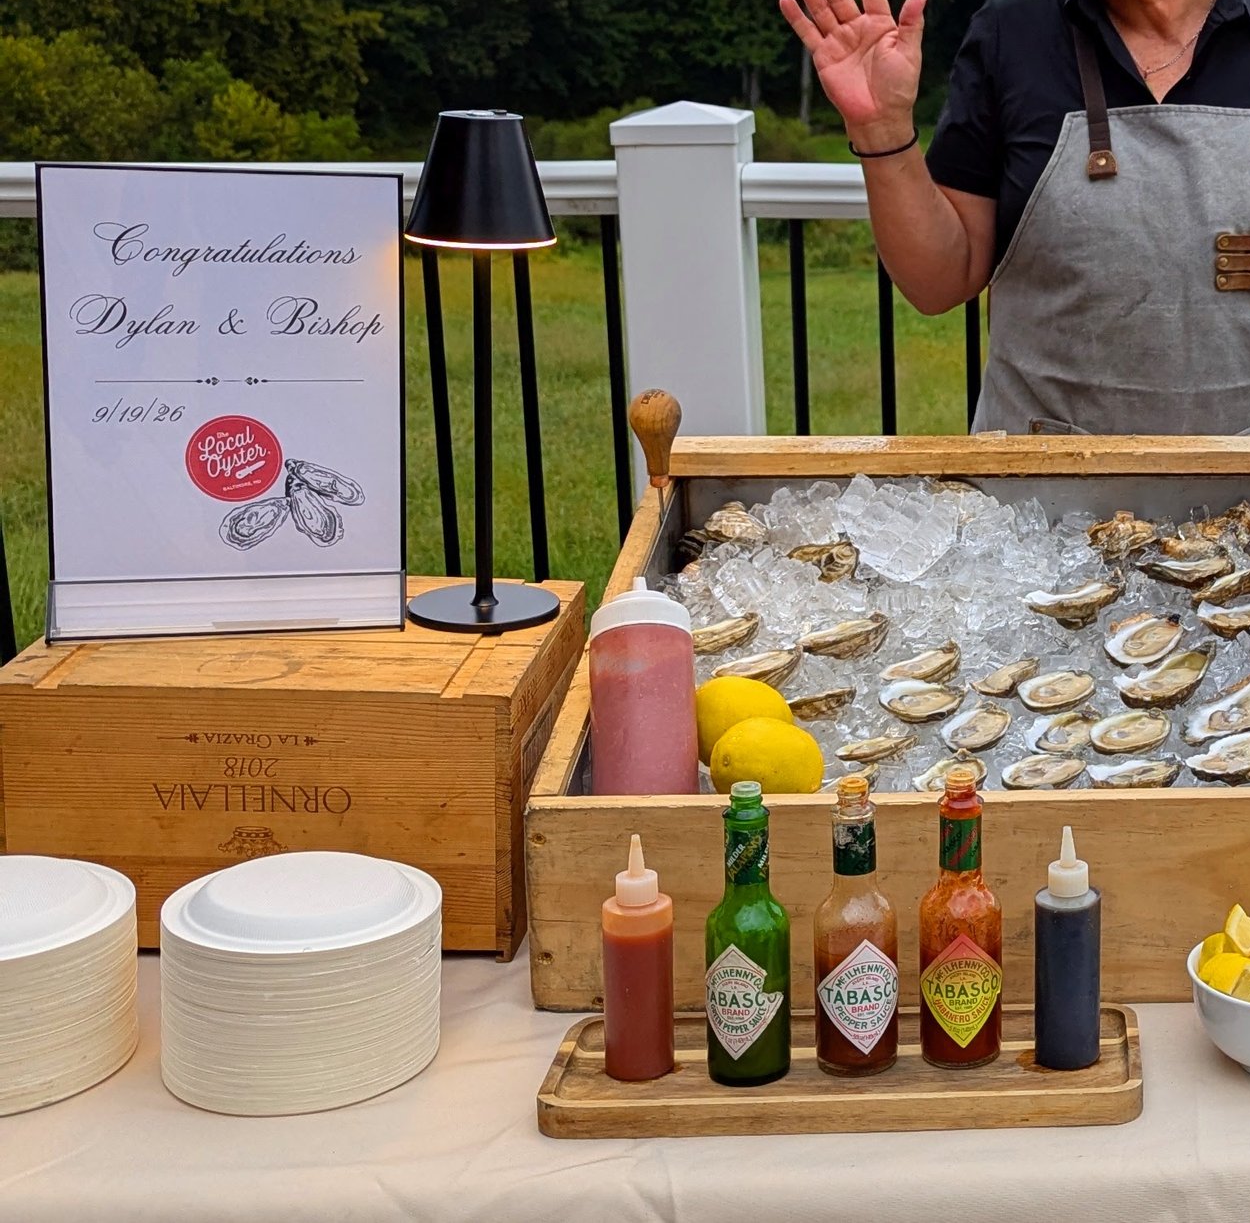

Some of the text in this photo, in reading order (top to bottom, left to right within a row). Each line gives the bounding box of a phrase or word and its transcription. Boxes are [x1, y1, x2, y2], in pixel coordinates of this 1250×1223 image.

[93, 221, 362, 277] Congratulations
[69, 293, 384, 349] Dylan & Bishop
[92, 398, 186, 424] 9/19/26
[198, 425, 255, 461] Local
[207, 443, 267, 478] Oyster
[204, 732, 299, 748] LA GRAZIA
[224, 756, 280, 778] 2018
[152, 783, 351, 813] ORNELLAIA
[727, 843, 746, 868] MILDER
[707, 990, 777, 1009] ABASC
[823, 976, 898, 1006] TABASCO
[926, 974, 999, 999] TABASCO
[721, 1007, 750, 1017] BRAND
[835, 998, 893, 1030] PEPPER SAUCE
[851, 1002, 880, 1014] BRAND
[934, 996, 990, 1023] HABANERO SAUCE
[949, 997, 978, 1006] BRAND
[722, 1023, 750, 1035] PEPPER
[749, 1007, 767, 1028] SAUCE
